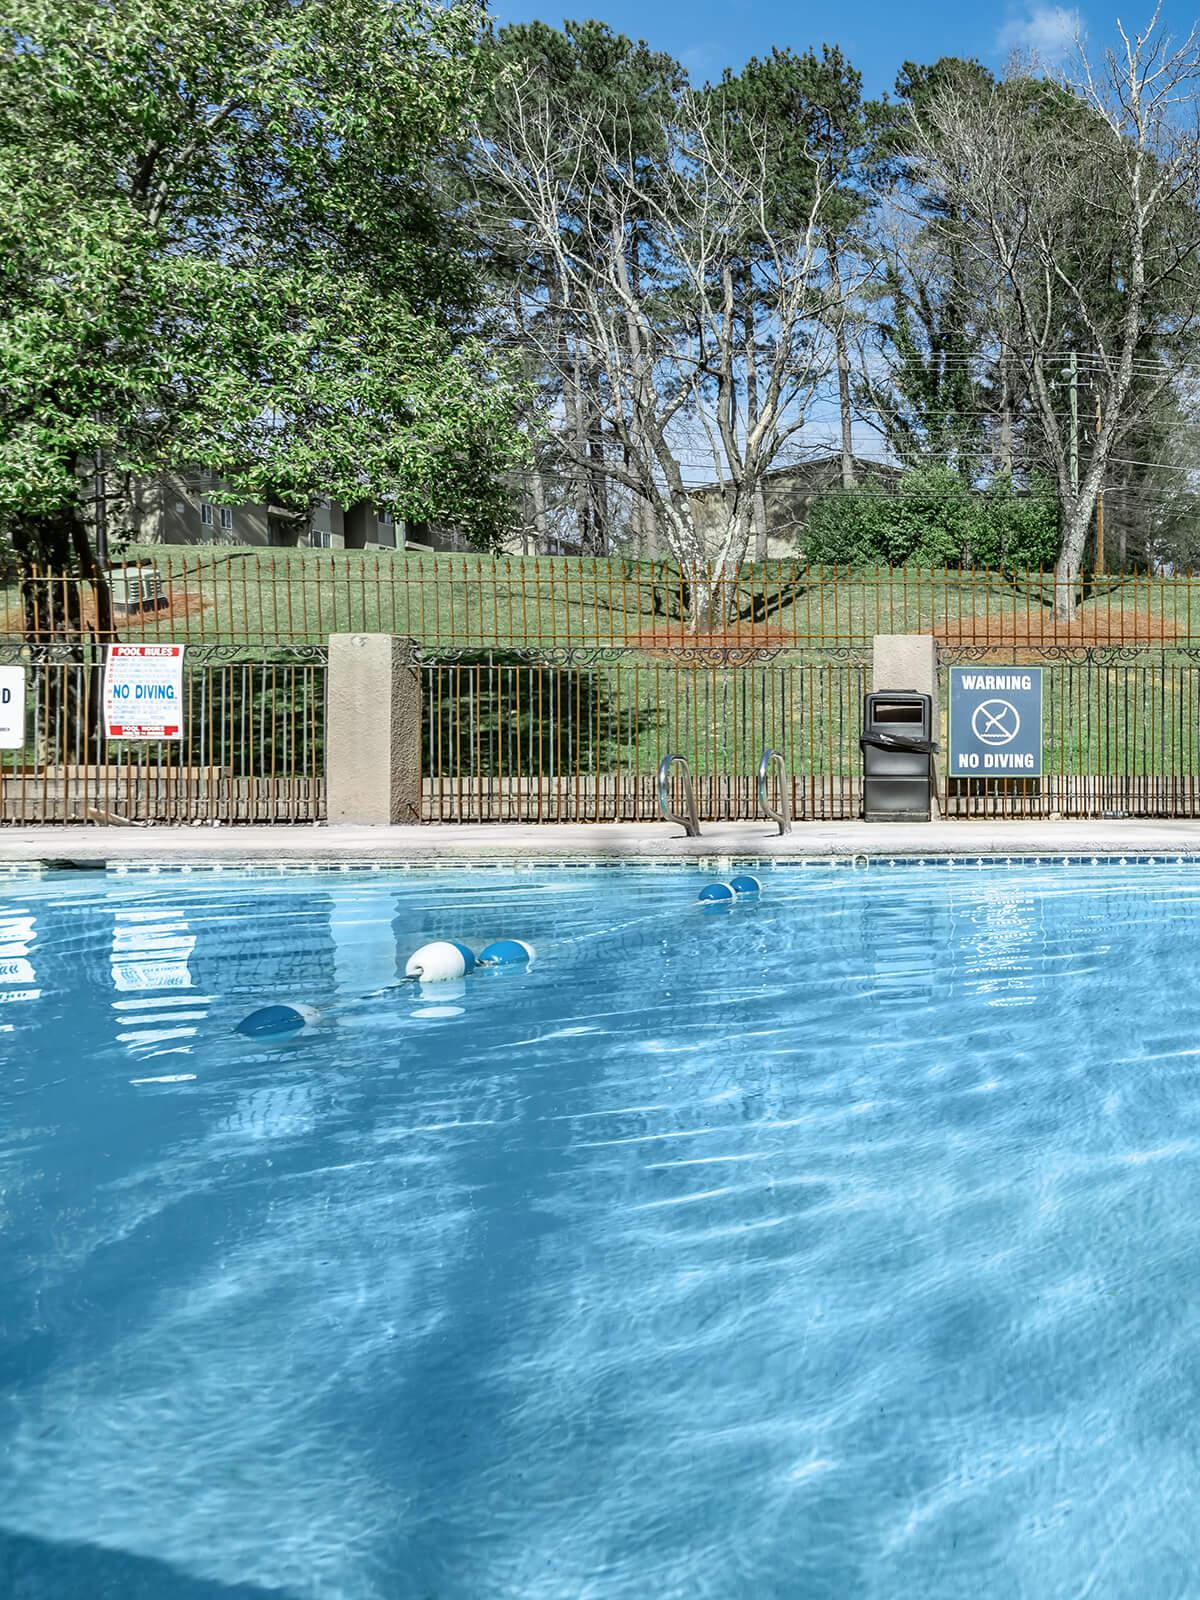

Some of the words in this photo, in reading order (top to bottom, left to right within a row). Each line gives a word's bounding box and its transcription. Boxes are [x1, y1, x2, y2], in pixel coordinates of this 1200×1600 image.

[118, 647, 141, 656] POOL
[144, 647, 173, 656] RULES
[961, 675, 1032, 690] WARNING
[113, 684, 129, 699] NO
[958, 753, 980, 769] NO
[983, 753, 1034, 769] DIVING
